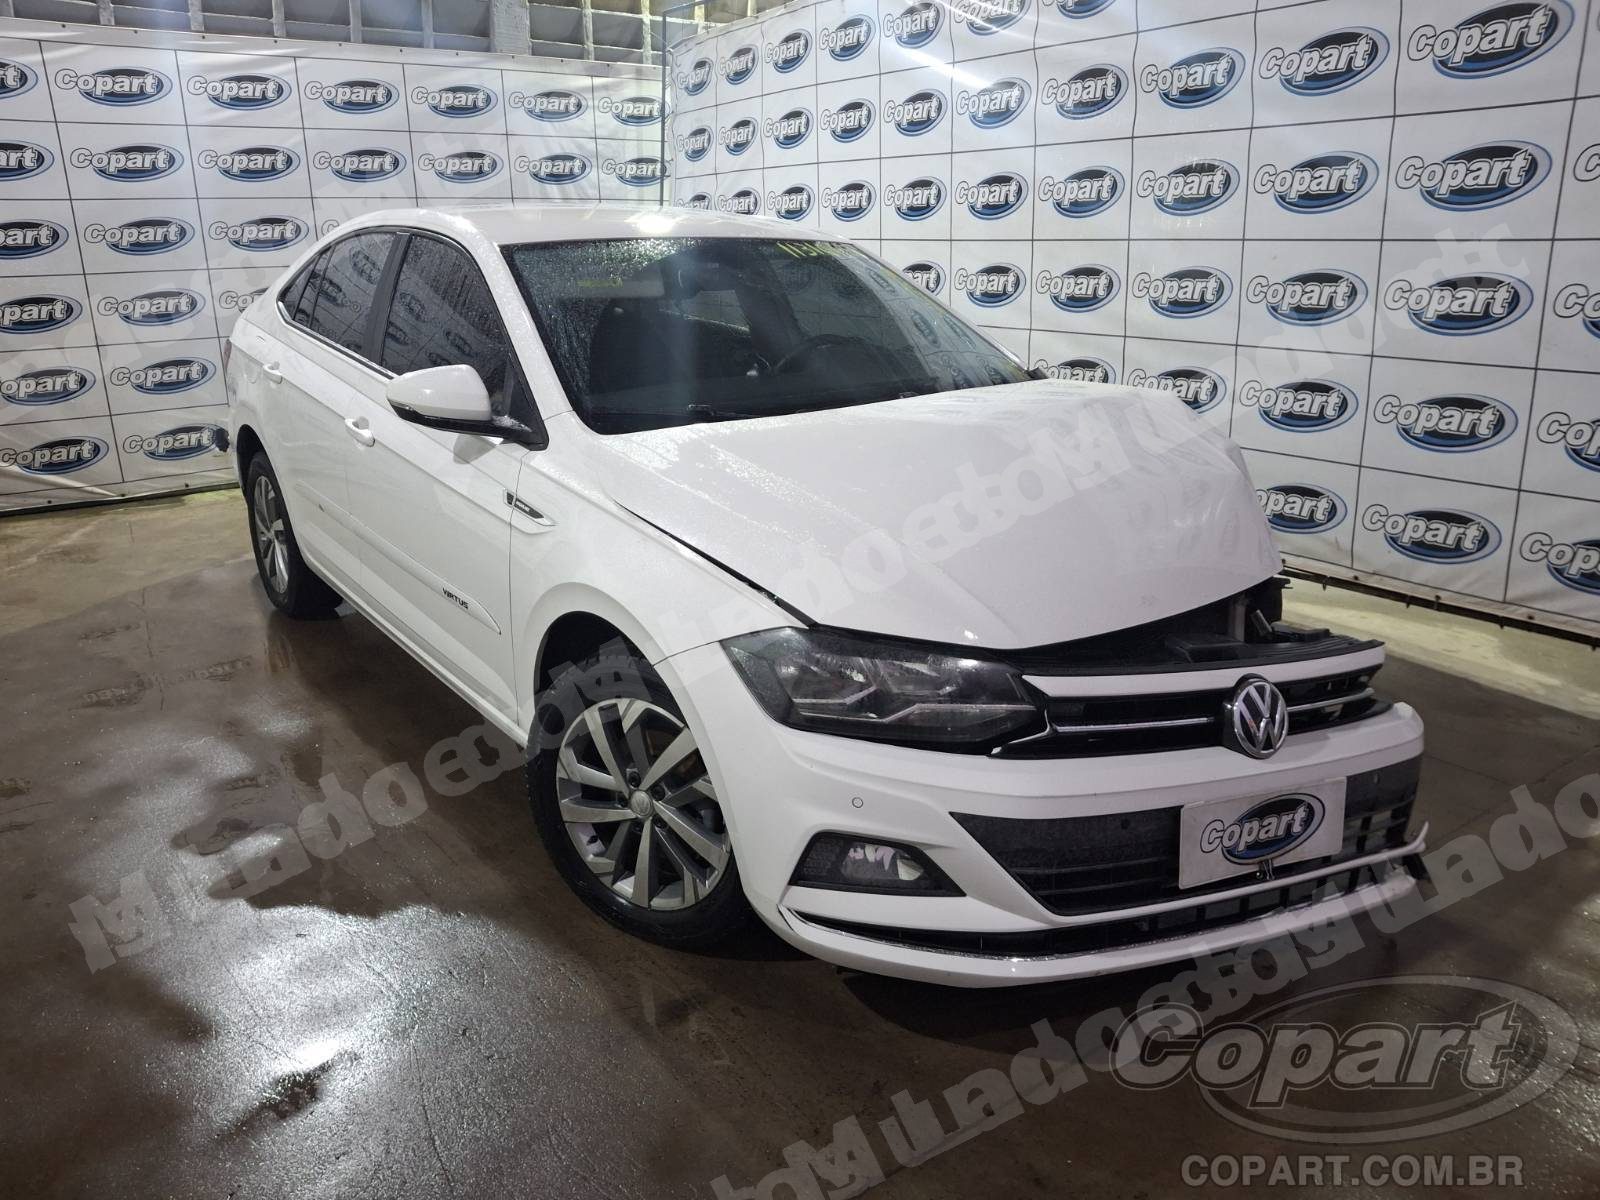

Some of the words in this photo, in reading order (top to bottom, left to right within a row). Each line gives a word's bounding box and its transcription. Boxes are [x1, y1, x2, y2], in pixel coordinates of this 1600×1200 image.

[883, 5, 938, 38] Copart
[1407, 4, 1552, 66] Copart
[765, 36, 808, 63] Copart
[820, 22, 869, 51] Copart
[1259, 34, 1373, 84] Copart
[55, 68, 158, 94] Copart
[187, 76, 279, 100] Copart
[1140, 53, 1233, 96] Copart
[304, 82, 388, 106] Copart
[411, 86, 488, 109] Copart
[509, 91, 580, 113] Copart
[956, 86, 1022, 118] Copart
[1042, 71, 1118, 108] Copart
[599, 97, 662, 117] Copart
[820, 104, 870, 130] Copart
[883, 95, 939, 126] Copart
[763, 115, 808, 139] Copart
[71, 148, 170, 172] Copart
[198, 149, 288, 173] Copart
[313, 151, 396, 173] Copart
[418, 153, 493, 174] Copart
[514, 155, 583, 175] Copart
[602, 159, 662, 177] Copart
[1396, 148, 1531, 197] Copart
[955, 176, 1021, 209] Copart
[1038, 171, 1116, 207] Copart
[1137, 167, 1228, 205] Copart
[1254, 159, 1362, 200] Copart
[767, 187, 810, 214] Copart
[821, 187, 871, 213] Copart
[884, 184, 940, 209] Copart
[84, 221, 182, 247] Copart
[209, 217, 298, 244] Copart
[954, 268, 1018, 296] Copart
[1035, 270, 1111, 300] Copart
[1132, 273, 1222, 305] Copart
[1247, 275, 1352, 314] Copart
[0, 299, 66, 326] part
[97, 293, 192, 316] Copart
[1384, 279, 1514, 320] Copart
[110, 361, 202, 387] Copart
[1240, 380, 1343, 417] Copart
[1374, 394, 1501, 437] Copart
[0, 438, 94, 468] Copart
[123, 427, 214, 453] Copart
[1362, 504, 1486, 551] Copart
[1520, 532, 1600, 576] Cop
[442, 588, 469, 610] VIRTUS
[1200, 800, 1311, 854] Copart
